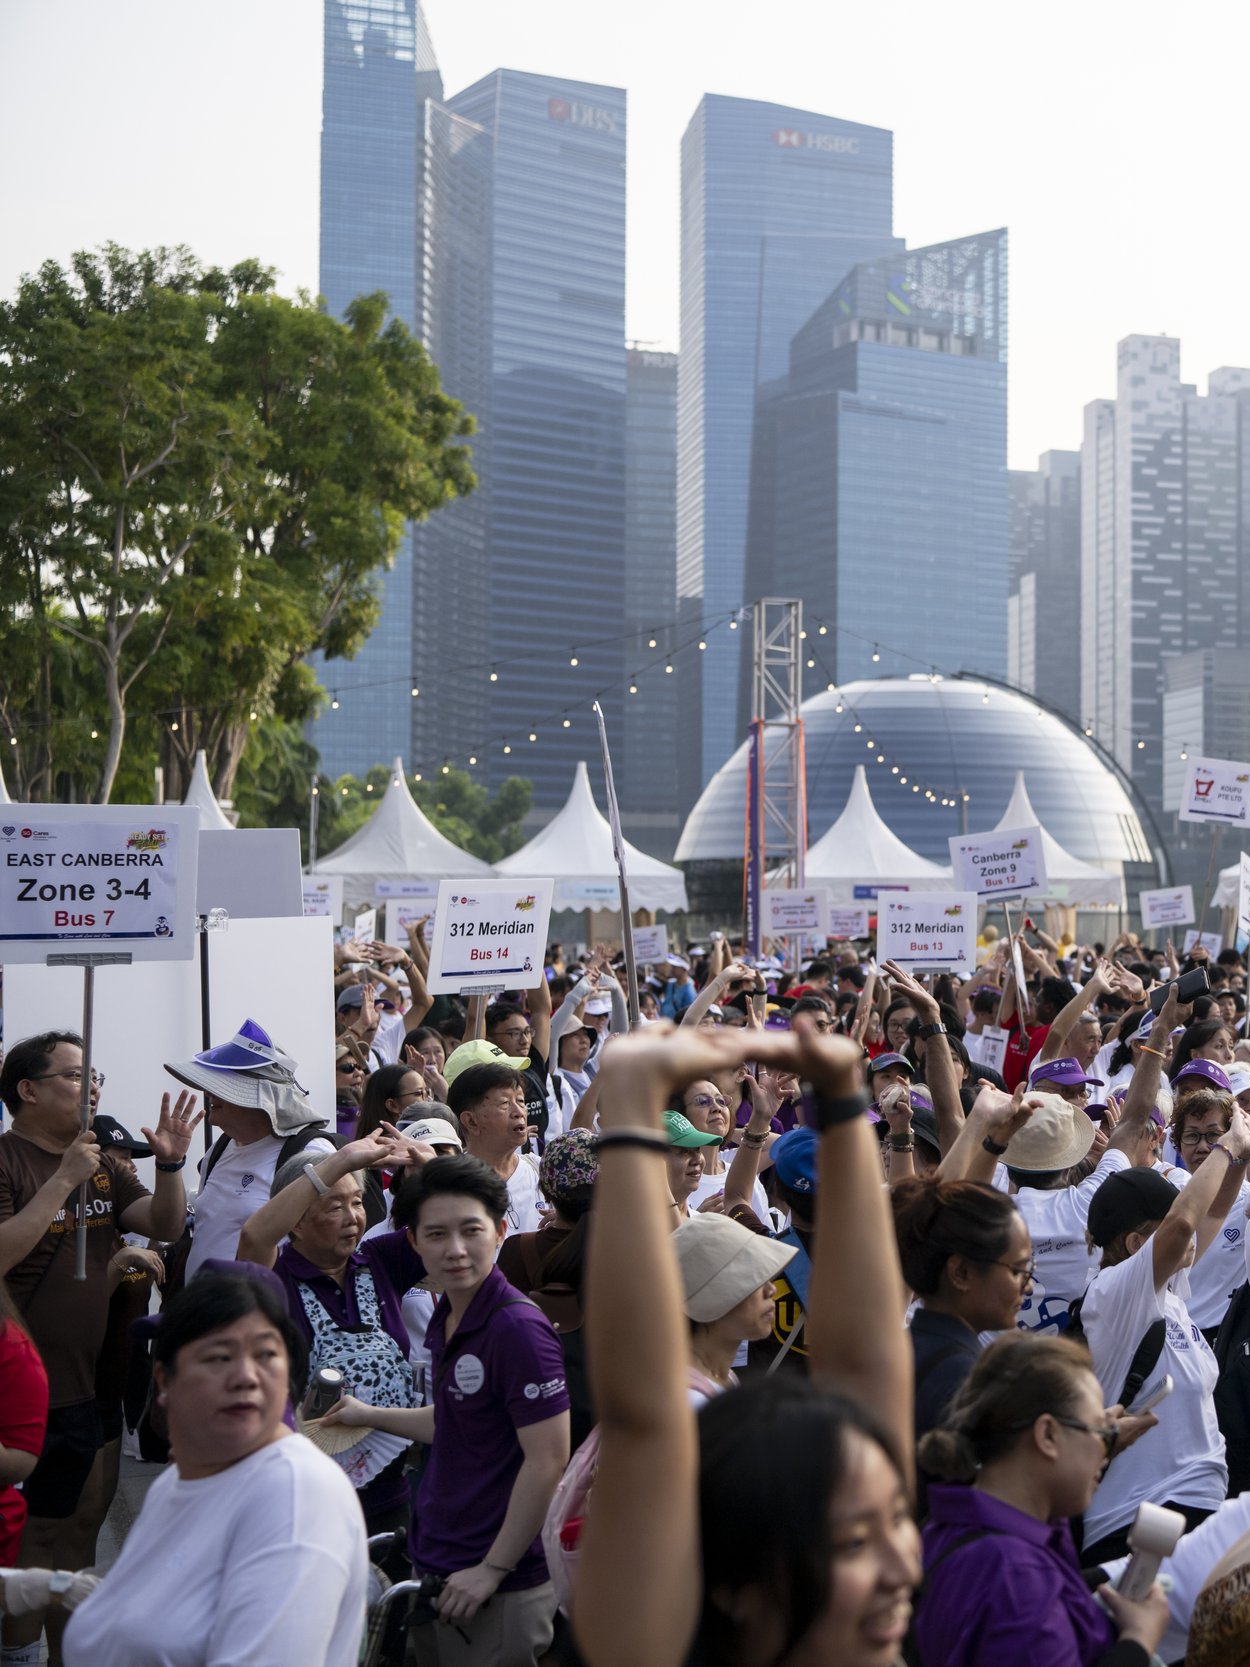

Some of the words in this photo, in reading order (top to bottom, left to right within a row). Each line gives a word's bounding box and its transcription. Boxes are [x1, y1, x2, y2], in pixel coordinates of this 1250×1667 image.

[807, 131, 861, 154] HSBC
[7, 853, 56, 867] EAST
[62, 853, 164, 867] CANBERRA
[972, 850, 1022, 865] Canberra
[980, 866, 1008, 878] Zone
[1009, 864, 1017, 873] 9
[985, 879, 1003, 887] Bus
[1006, 875, 1016, 884] 12
[16, 878, 96, 901] Zone
[106, 878, 152, 901] 3-4
[55, 910, 96, 926] Bus
[103, 910, 115, 926] 7
[450, 922, 474, 937] 312
[478, 920, 534, 936] Meridian
[890, 922, 911, 934] 312
[914, 922, 964, 933] Meridian
[910, 942, 929, 951] Bus
[932, 942, 943, 951] 13
[470, 948, 492, 961] Bus
[496, 947, 509, 959] 14
[1036, 1238, 1052, 1248] with
[1038, 1246, 1053, 1255] and
